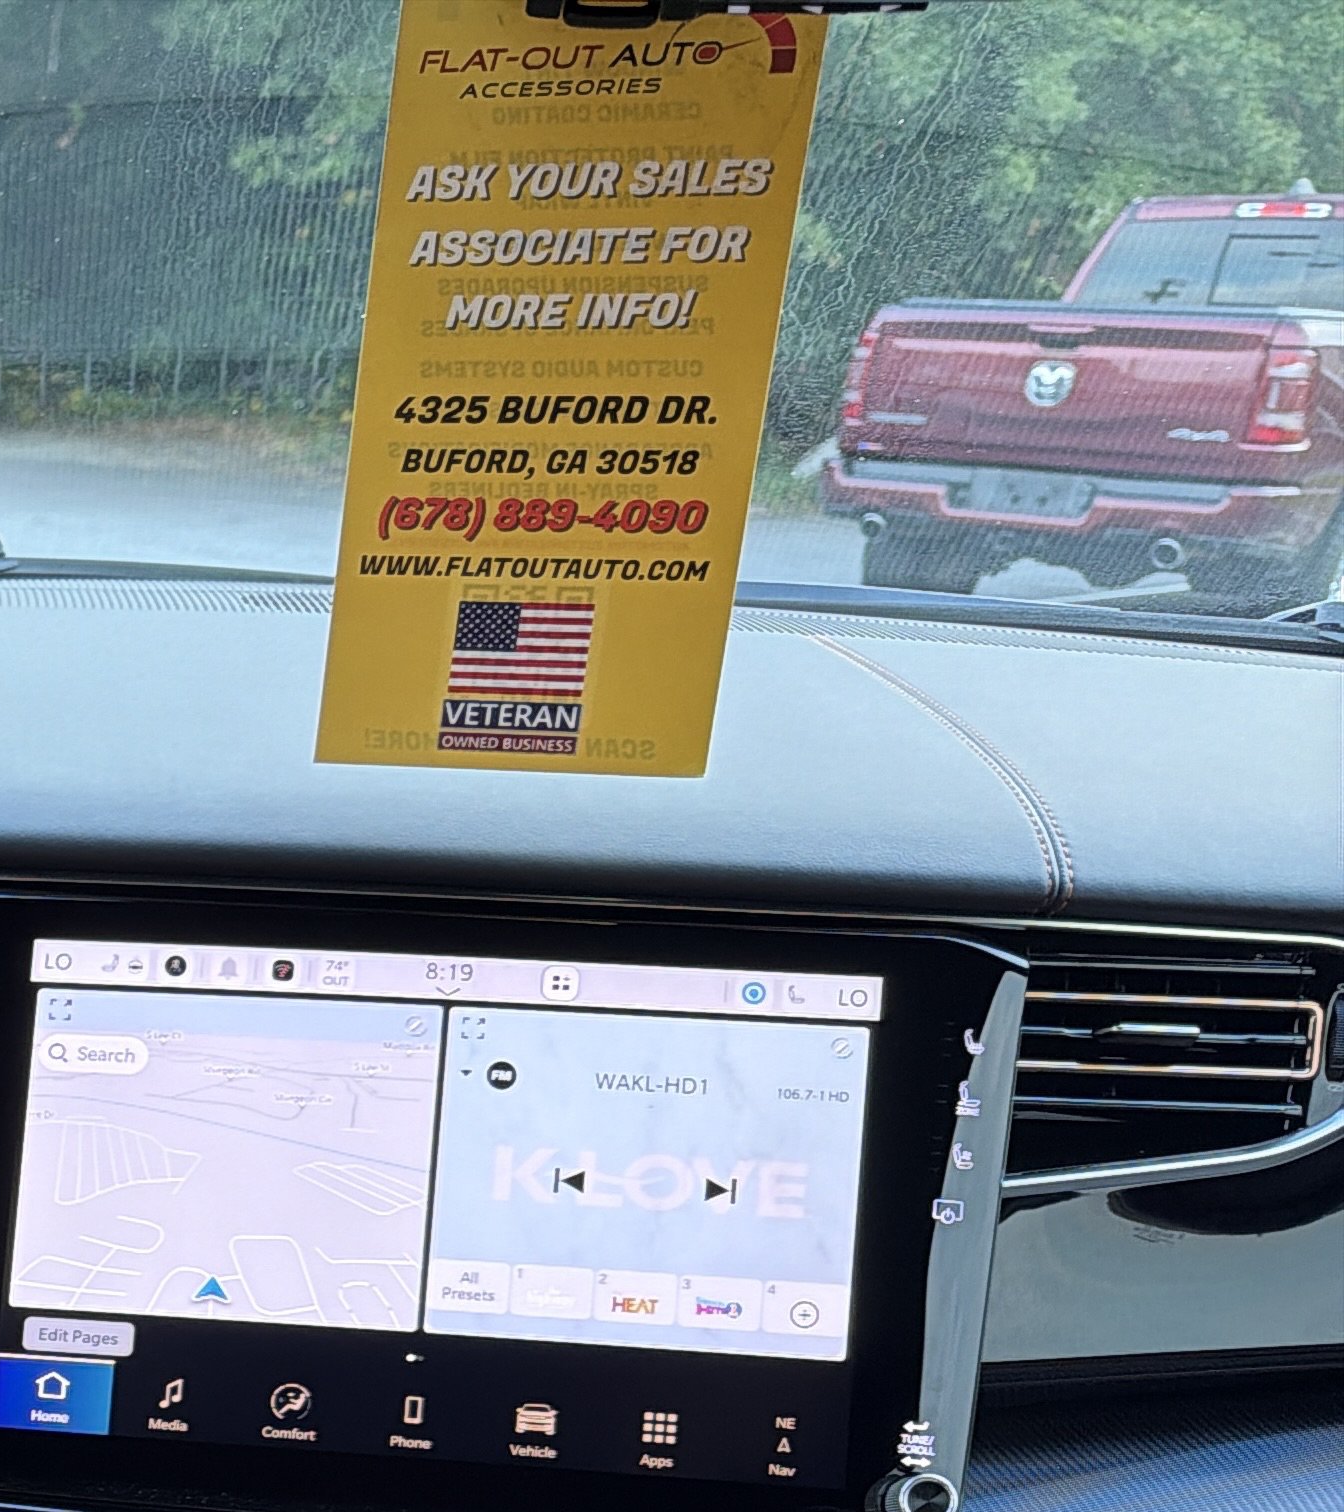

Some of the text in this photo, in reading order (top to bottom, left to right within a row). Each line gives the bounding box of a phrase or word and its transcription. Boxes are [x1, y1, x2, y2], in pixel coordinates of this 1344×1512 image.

[419, 41, 724, 74] FLAT-OUT AUTO
[459, 78, 662, 100] ACCESSORIES
[406, 162, 495, 201] ASK
[507, 160, 618, 198] YOUR
[629, 157, 774, 196] SALES
[410, 224, 750, 266] ASSOCIATE FOR
[445, 293, 573, 330] MORE
[578, 289, 698, 328] INFO!
[394, 395, 717, 426] 4325 BUFORD DR.
[401, 449, 535, 479] BUFORD,
[546, 450, 587, 475] GA
[597, 450, 700, 476] 30518
[378, 496, 708, 541] (678) 889-4090
[360, 554, 710, 582] WWW.FLATOUTAUTO.COM
[445, 701, 579, 731] VETERAN
[442, 735, 574, 754] OWNED BUSINESS
[44, 952, 73, 971] LO
[425, 962, 474, 983] 8:19
[838, 988, 868, 1008] LO
[77, 1045, 136, 1065] Search
[594, 1071, 709, 1096] WAKL-HD1
[459, 1271, 480, 1285] All
[441, 1287, 496, 1303] Presets
[612, 1297, 660, 1315] HEAT
[38, 1327, 119, 1348] Edit Pages
[30, 1409, 69, 1425] Home
[148, 1417, 188, 1433] Media
[775, 1416, 797, 1430] NE
[261, 1425, 318, 1442] Comfort
[389, 1435, 433, 1451] Phone
[509, 1443, 559, 1460] Vehicle
[639, 1454, 674, 1470] Apps
[768, 1462, 796, 1478] Nav
